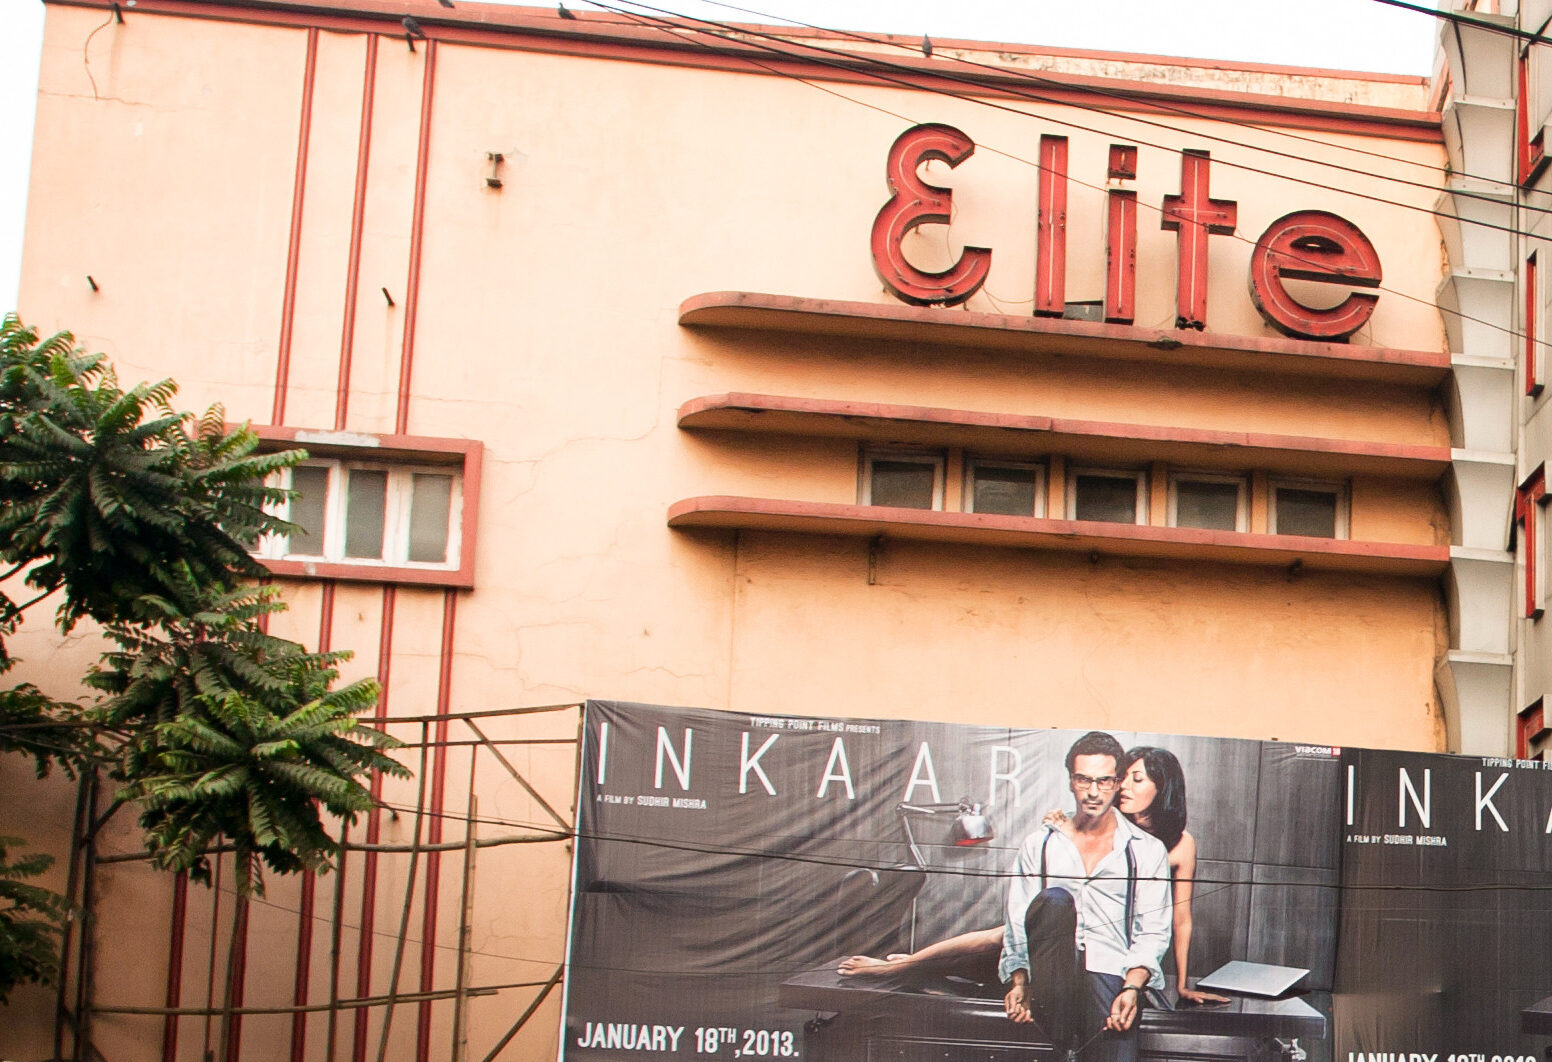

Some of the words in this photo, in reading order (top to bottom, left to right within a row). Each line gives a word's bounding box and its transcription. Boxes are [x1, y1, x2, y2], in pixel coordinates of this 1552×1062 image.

[871, 123, 1382, 343] Elite
[750, 717, 784, 730] TIPPING
[788, 719, 815, 731] POINT
[817, 720, 844, 733] FILMS
[597, 722, 1022, 808] INKAAR
[1481, 757, 1513, 769] TIPPING
[1516, 759, 1539, 770] POINT
[604, 795, 621, 804] FILM
[624, 796, 634, 805] BY
[637, 796, 670, 808] SUDHIR
[673, 798, 707, 810] MISHRA
[1354, 835, 1369, 844] FILM
[1371, 836, 1381, 844] BY
[1384, 834, 1413, 846] SUDHIR
[1416, 836, 1447, 847] MISHRA
[577, 1022, 684, 1051] JANUARY
